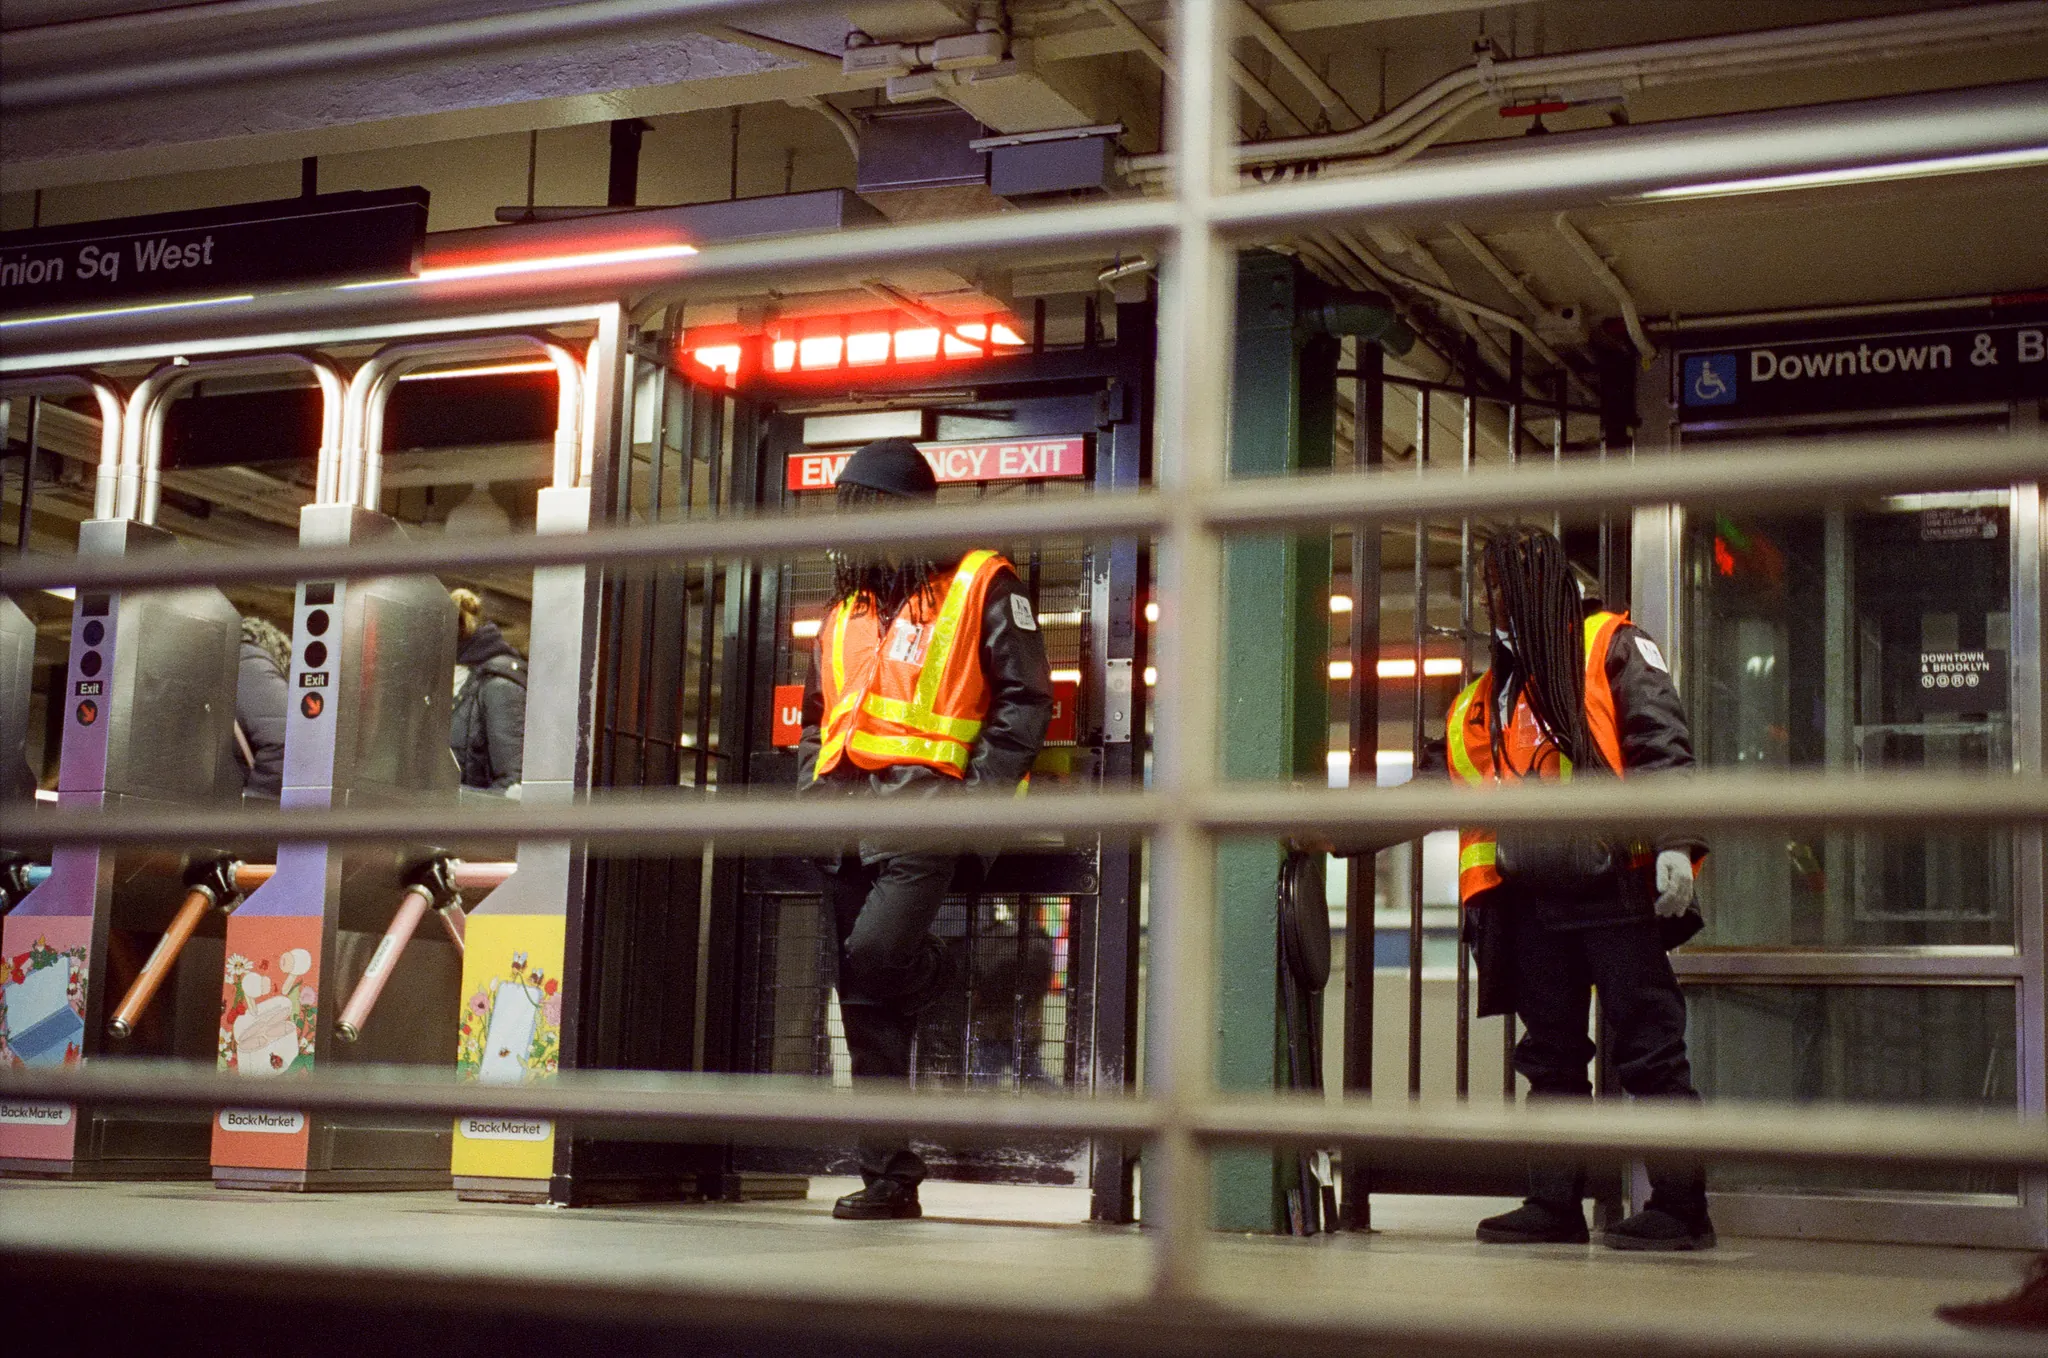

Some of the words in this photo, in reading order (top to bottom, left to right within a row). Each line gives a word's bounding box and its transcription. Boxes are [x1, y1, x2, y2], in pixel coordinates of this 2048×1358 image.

[0, 253, 64, 287] nion
[76, 245, 120, 282] Sq
[134, 235, 214, 273] West
[1750, 343, 1952, 382] Downtown
[1970, 333, 1999, 367] &
[2017, 330, 2048, 363] B
[802, 449, 988, 486] EMNCY
[999, 444, 1068, 475] EXIT
[1921, 652, 1984, 663] DOWNTOWN
[1921, 663, 1929, 673] &
[1932, 662, 1990, 673] BROOKLYN
[305, 674, 324, 687] Exit
[80, 683, 99, 695] Exit
